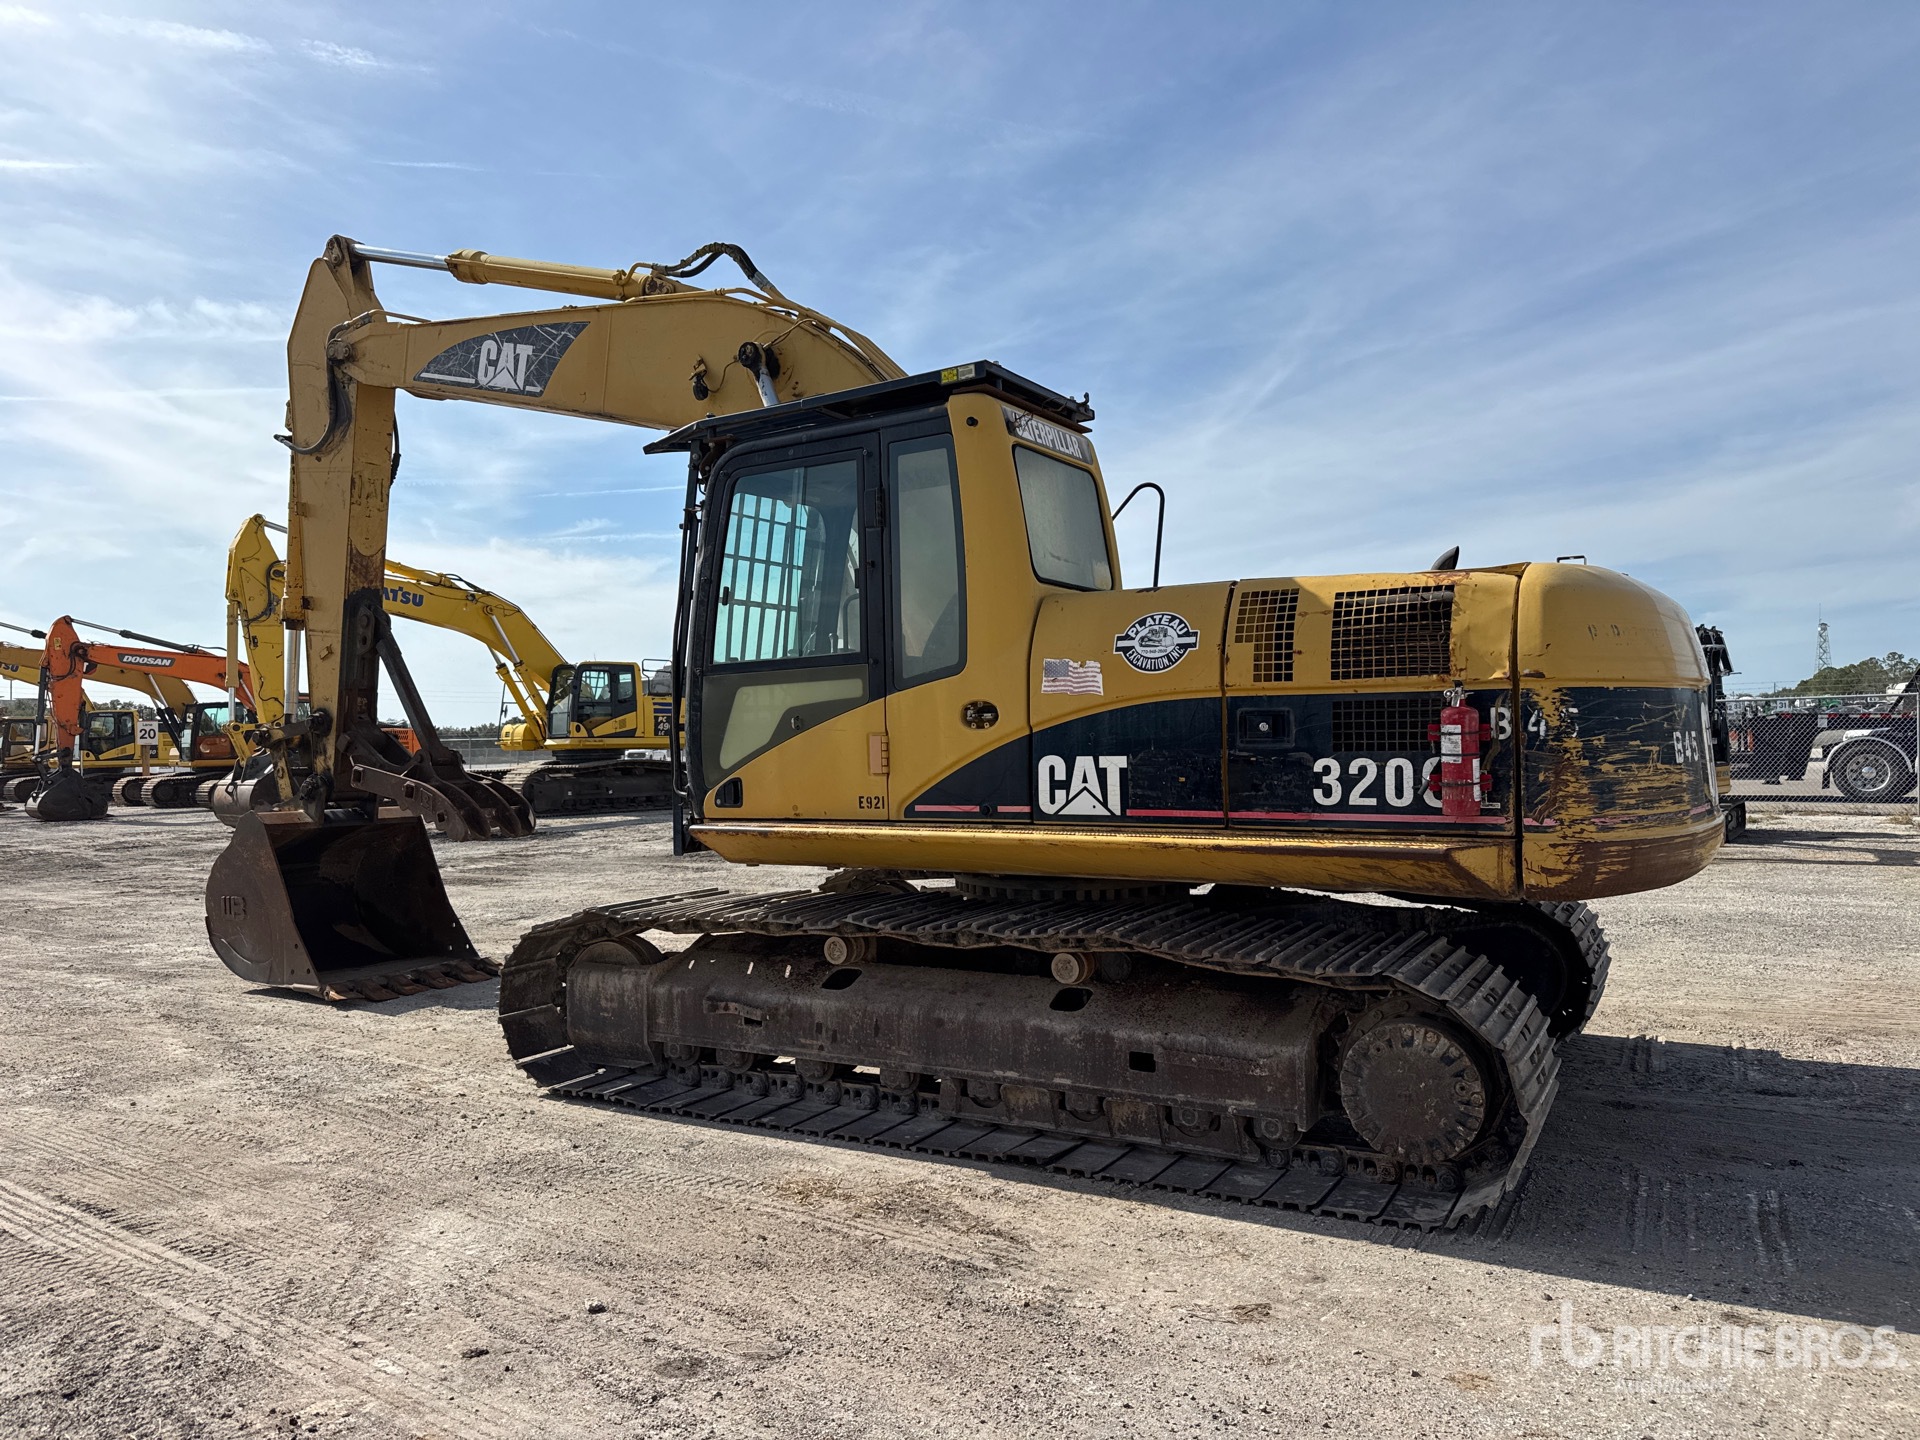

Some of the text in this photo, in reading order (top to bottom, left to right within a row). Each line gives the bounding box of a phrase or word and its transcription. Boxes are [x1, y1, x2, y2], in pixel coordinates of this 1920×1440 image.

[477, 339, 534, 390] CAT
[1127, 614, 1188, 638] PLATEAU
[123, 655, 171, 665] DOOSAN
[1127, 646, 1185, 669] EXCAVATION, INC.
[139, 728, 157, 740] 20
[657, 722, 671, 731] 49
[1037, 754, 1128, 816] CAT
